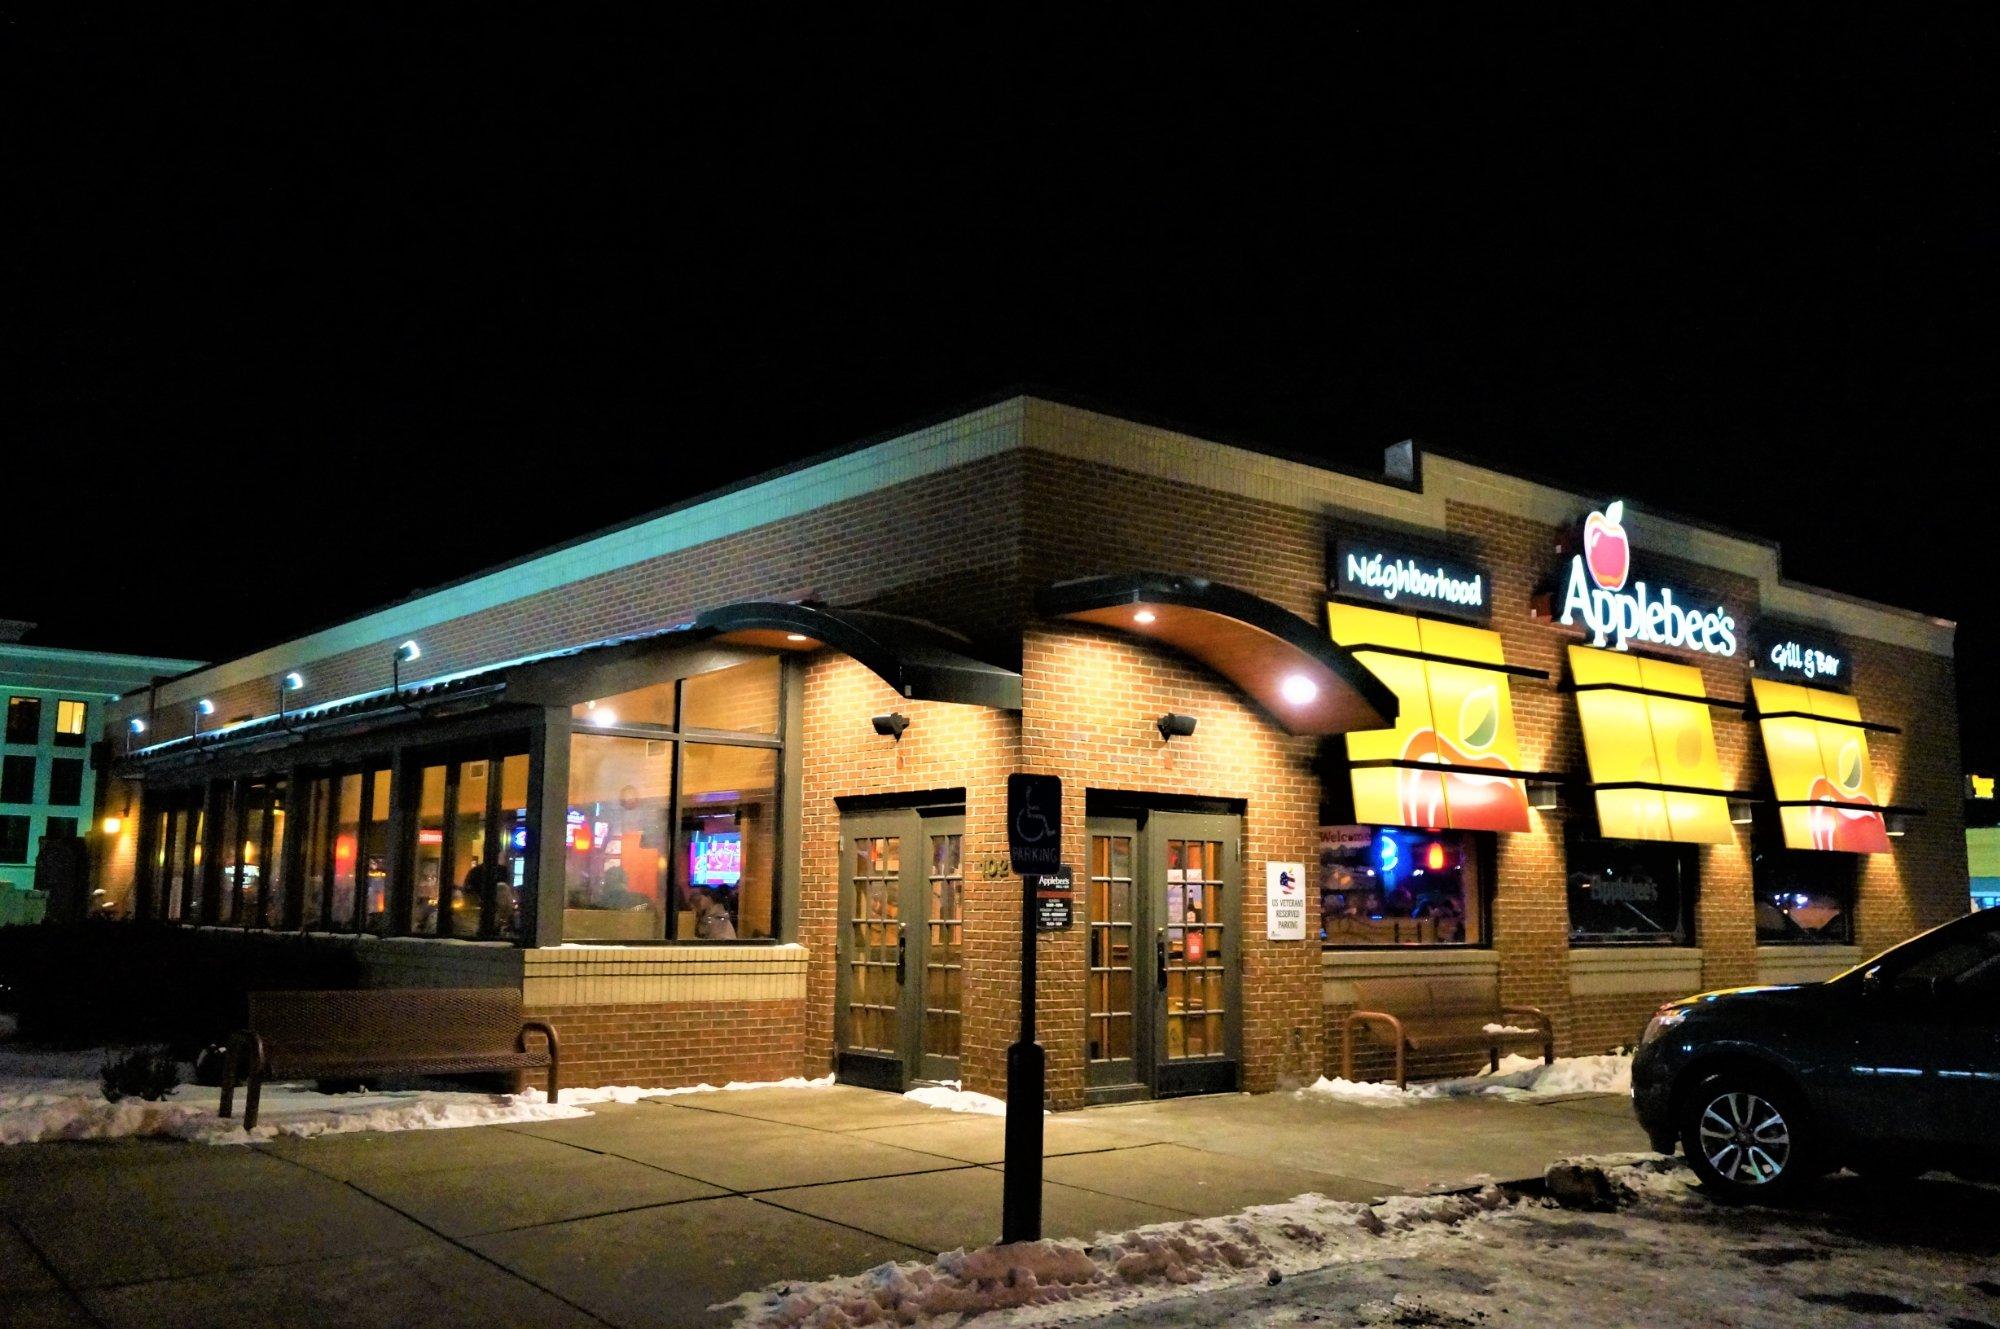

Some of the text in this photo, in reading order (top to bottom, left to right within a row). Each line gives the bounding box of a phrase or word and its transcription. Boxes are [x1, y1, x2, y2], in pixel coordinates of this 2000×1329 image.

[1347, 553, 1482, 606] Neighborhood
[1560, 554, 1737, 657] Applebee's
[1771, 641, 1803, 671] Grill
[1814, 650, 1839, 676] Bar
[1012, 846, 1058, 863] PARKING
[1272, 898, 1279, 908] US
